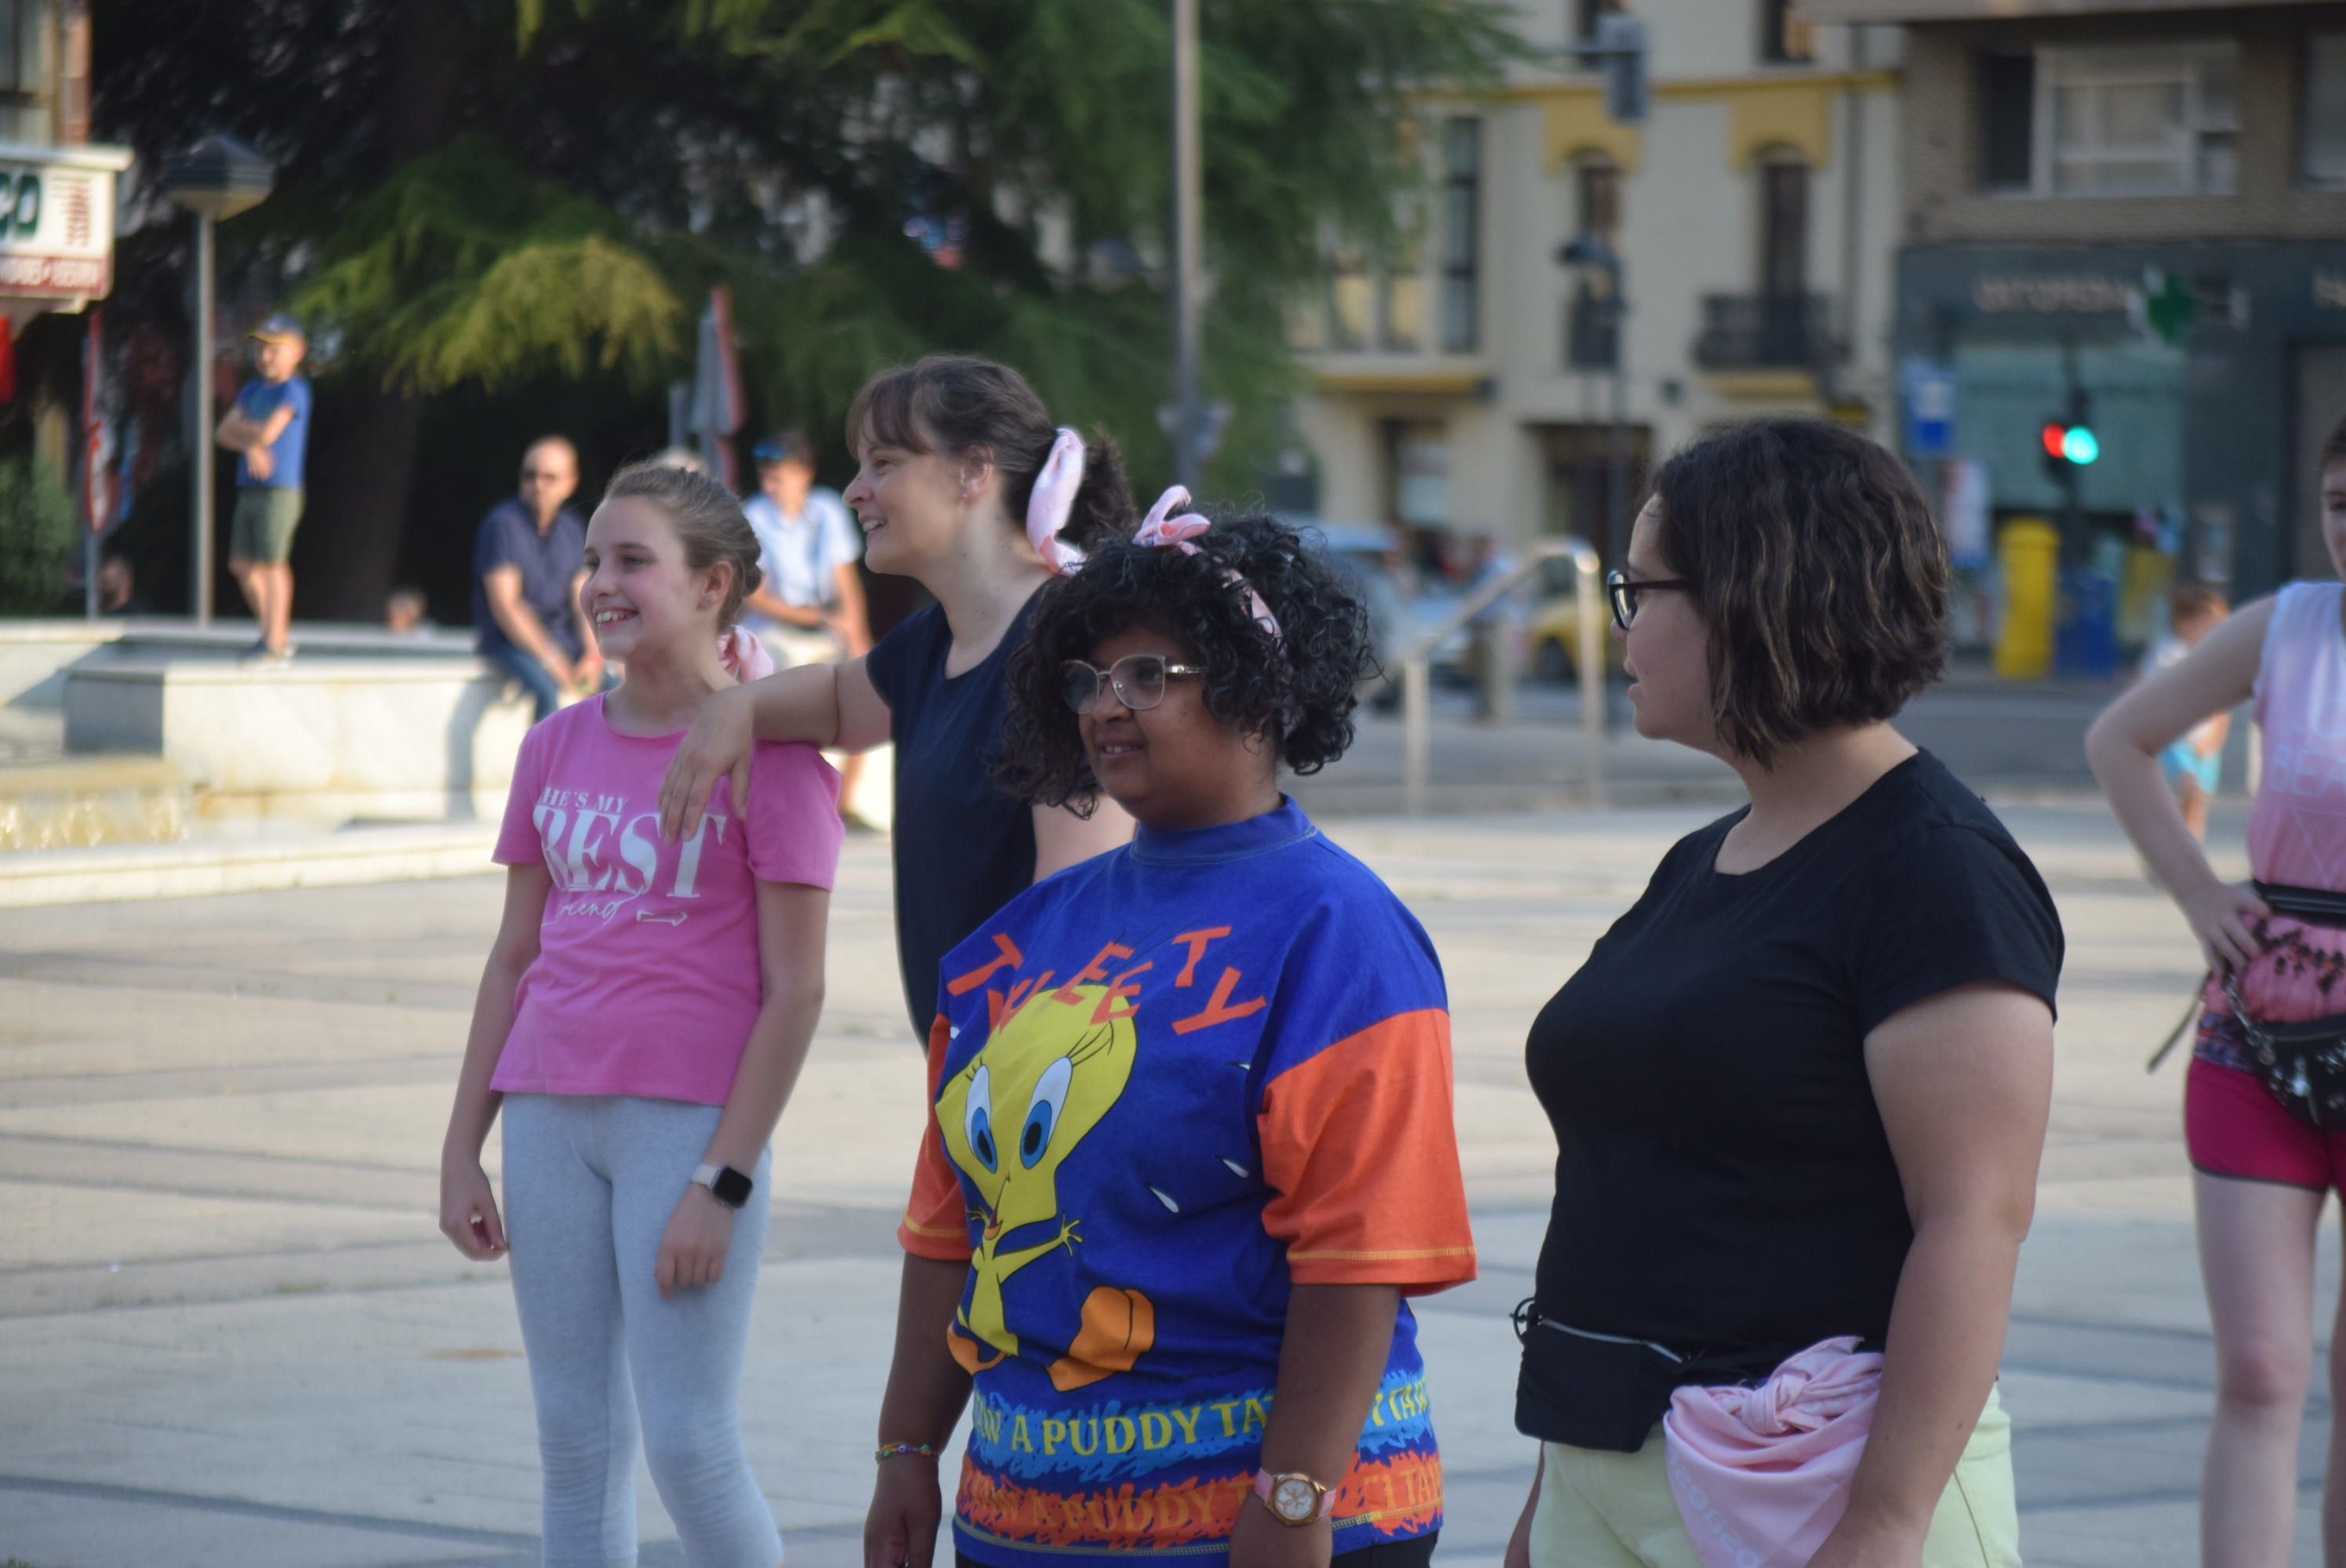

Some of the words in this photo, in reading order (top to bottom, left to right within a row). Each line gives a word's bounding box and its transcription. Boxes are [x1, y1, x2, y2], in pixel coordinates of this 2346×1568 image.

[595, 796, 630, 815] MY
[946, 924, 1268, 1036] TWEETY
[1011, 1414, 1033, 1454] A
[1041, 1406, 1202, 1456] PUDDY
[1062, 1479, 1216, 1532] PUDDY
